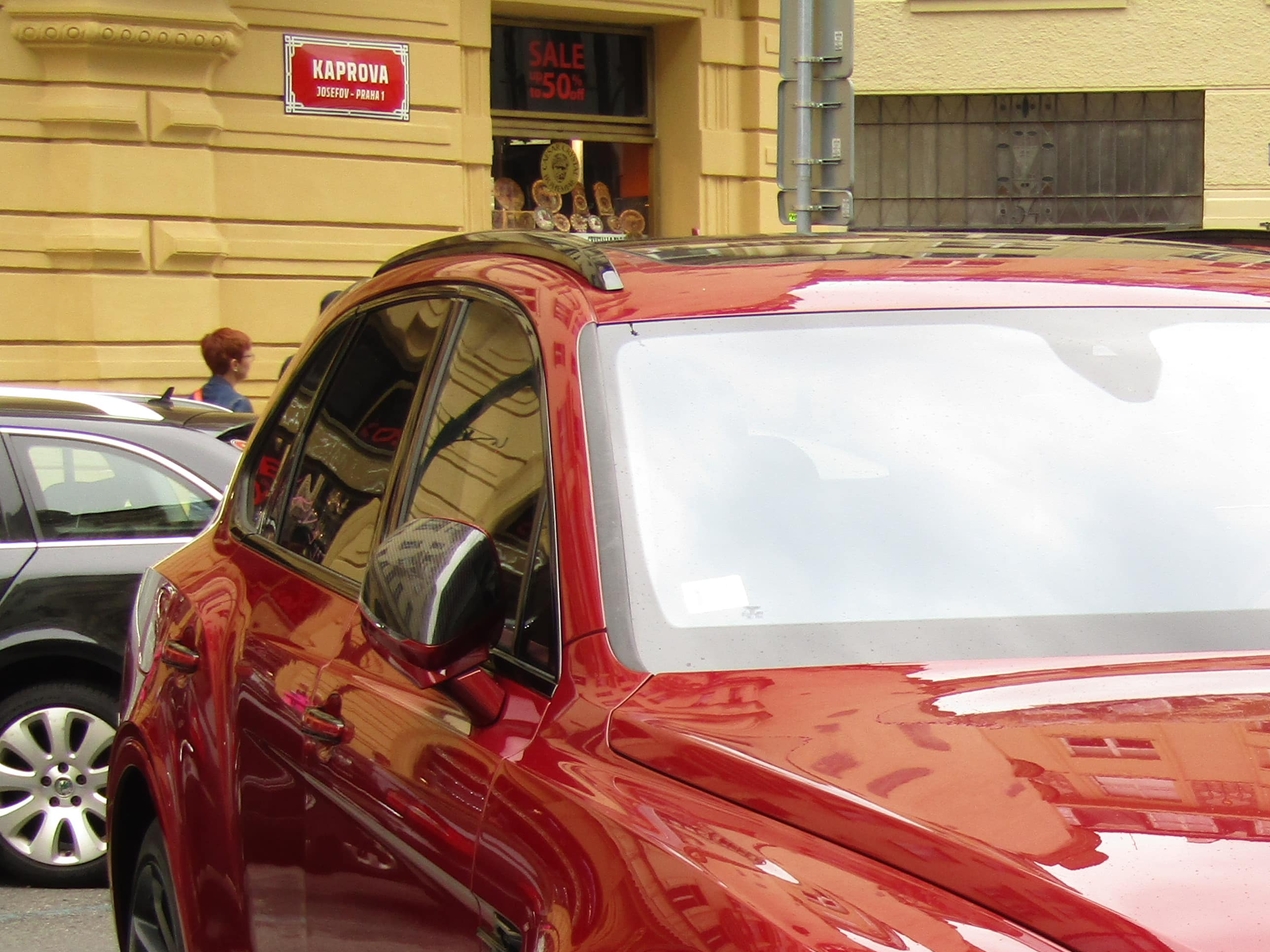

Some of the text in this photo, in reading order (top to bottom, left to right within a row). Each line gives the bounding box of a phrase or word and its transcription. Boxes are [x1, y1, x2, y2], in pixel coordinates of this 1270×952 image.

[530, 41, 586, 70] SALE
[313, 59, 389, 84] KAPROVA
[316, 86, 350, 99] JOSEFOV
[355, 89, 380, 101] PRAHA
[380, 91, 385, 101] 1
